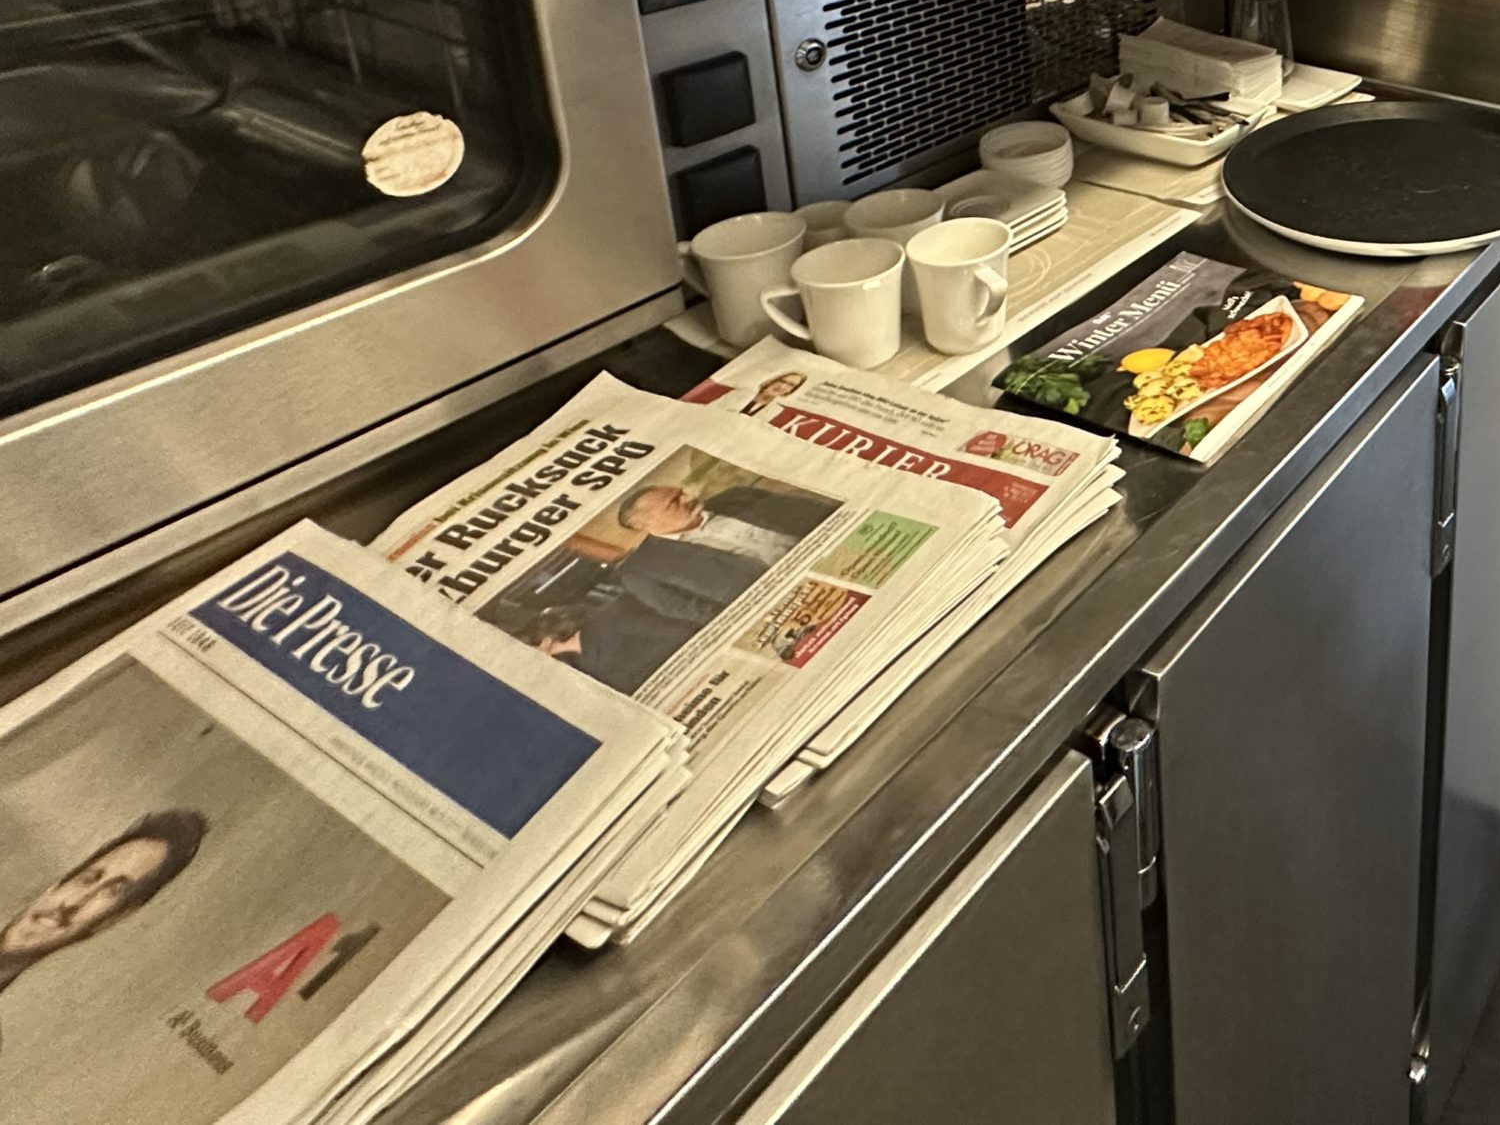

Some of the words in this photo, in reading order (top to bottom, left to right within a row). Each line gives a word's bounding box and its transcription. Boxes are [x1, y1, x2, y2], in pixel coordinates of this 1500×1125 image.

[1048, 317, 1129, 361] Winter
[1120, 280, 1181, 320] Menü
[434, 423, 631, 551] Rucksack
[781, 414, 952, 479] KURIER
[217, 564, 306, 632] Die
[270, 592, 415, 709] Presse
[204, 911, 382, 1026] A1
